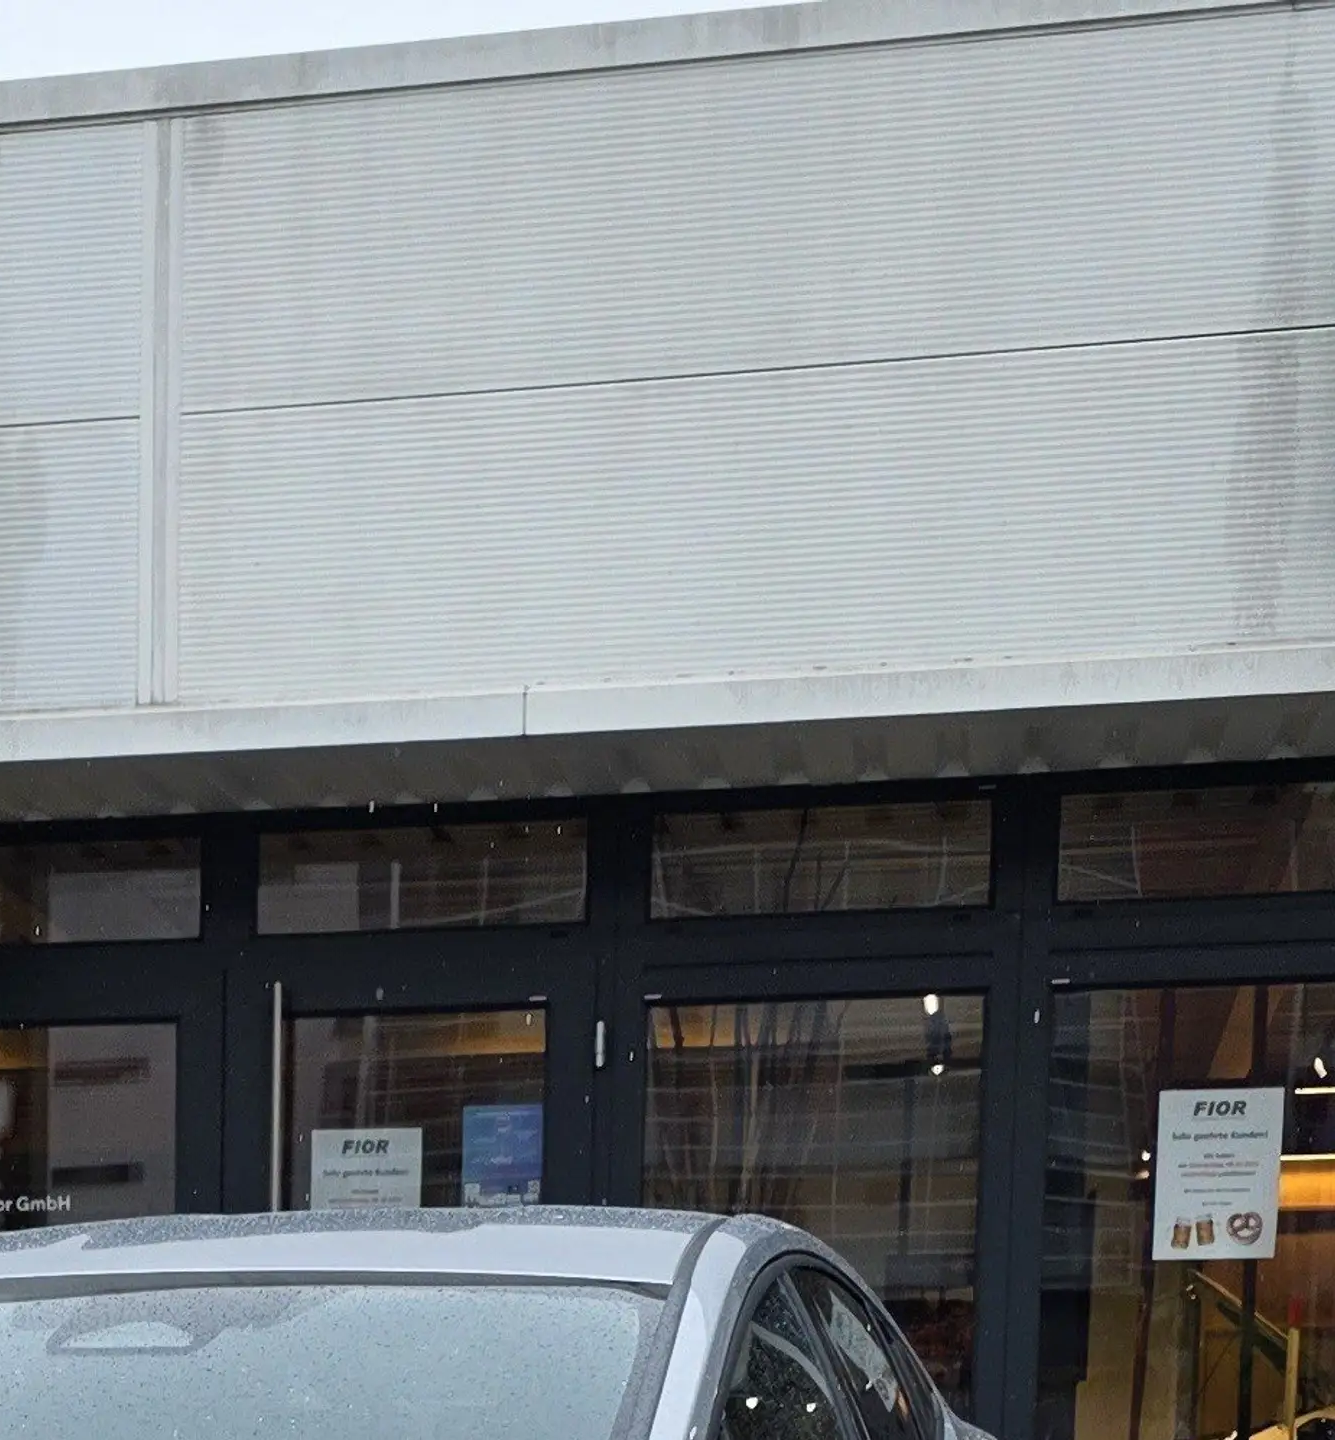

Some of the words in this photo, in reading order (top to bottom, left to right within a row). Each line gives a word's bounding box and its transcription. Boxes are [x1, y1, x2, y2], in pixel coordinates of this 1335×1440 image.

[1193, 1100, 1247, 1117] FIOR
[342, 1139, 389, 1154] FIOR
[16, 1194, 71, 1212] GmbH
